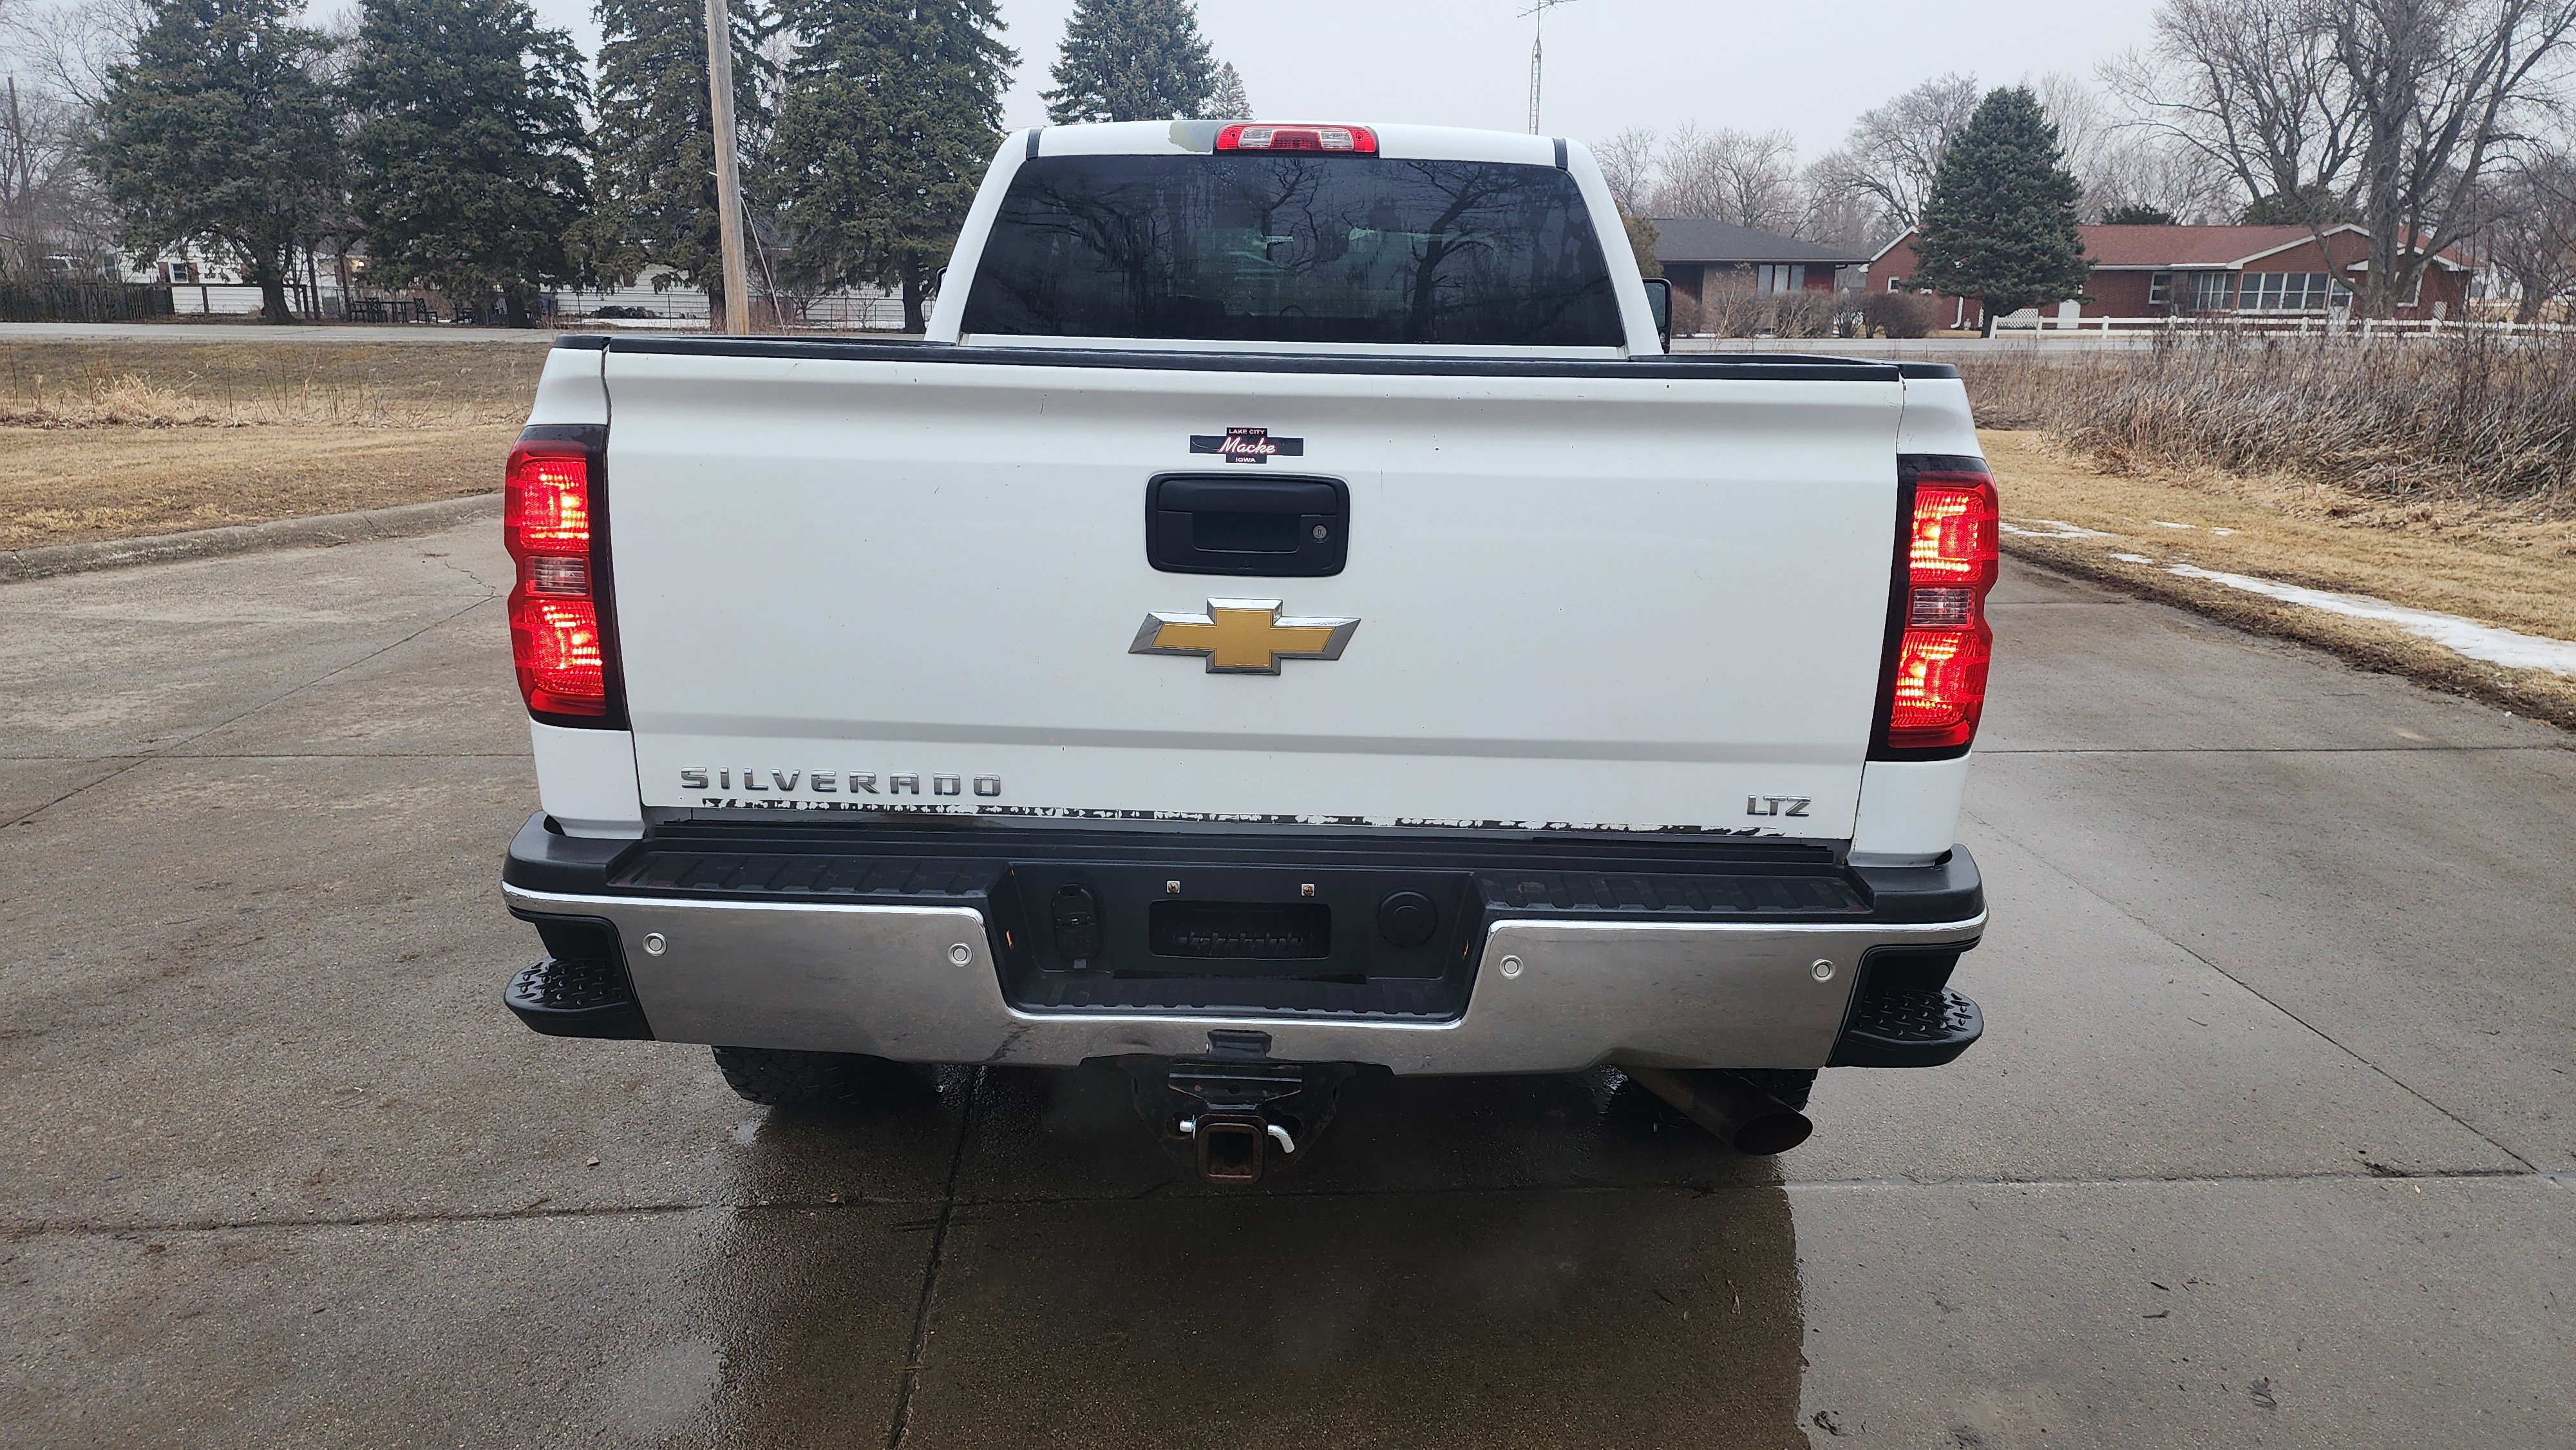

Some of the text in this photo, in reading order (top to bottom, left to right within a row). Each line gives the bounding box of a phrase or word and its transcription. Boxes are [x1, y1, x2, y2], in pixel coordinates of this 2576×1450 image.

[1218, 437, 1276, 453] Macke
[681, 766, 1001, 796] SILVERADO
[1747, 795, 1811, 816] LTZ
